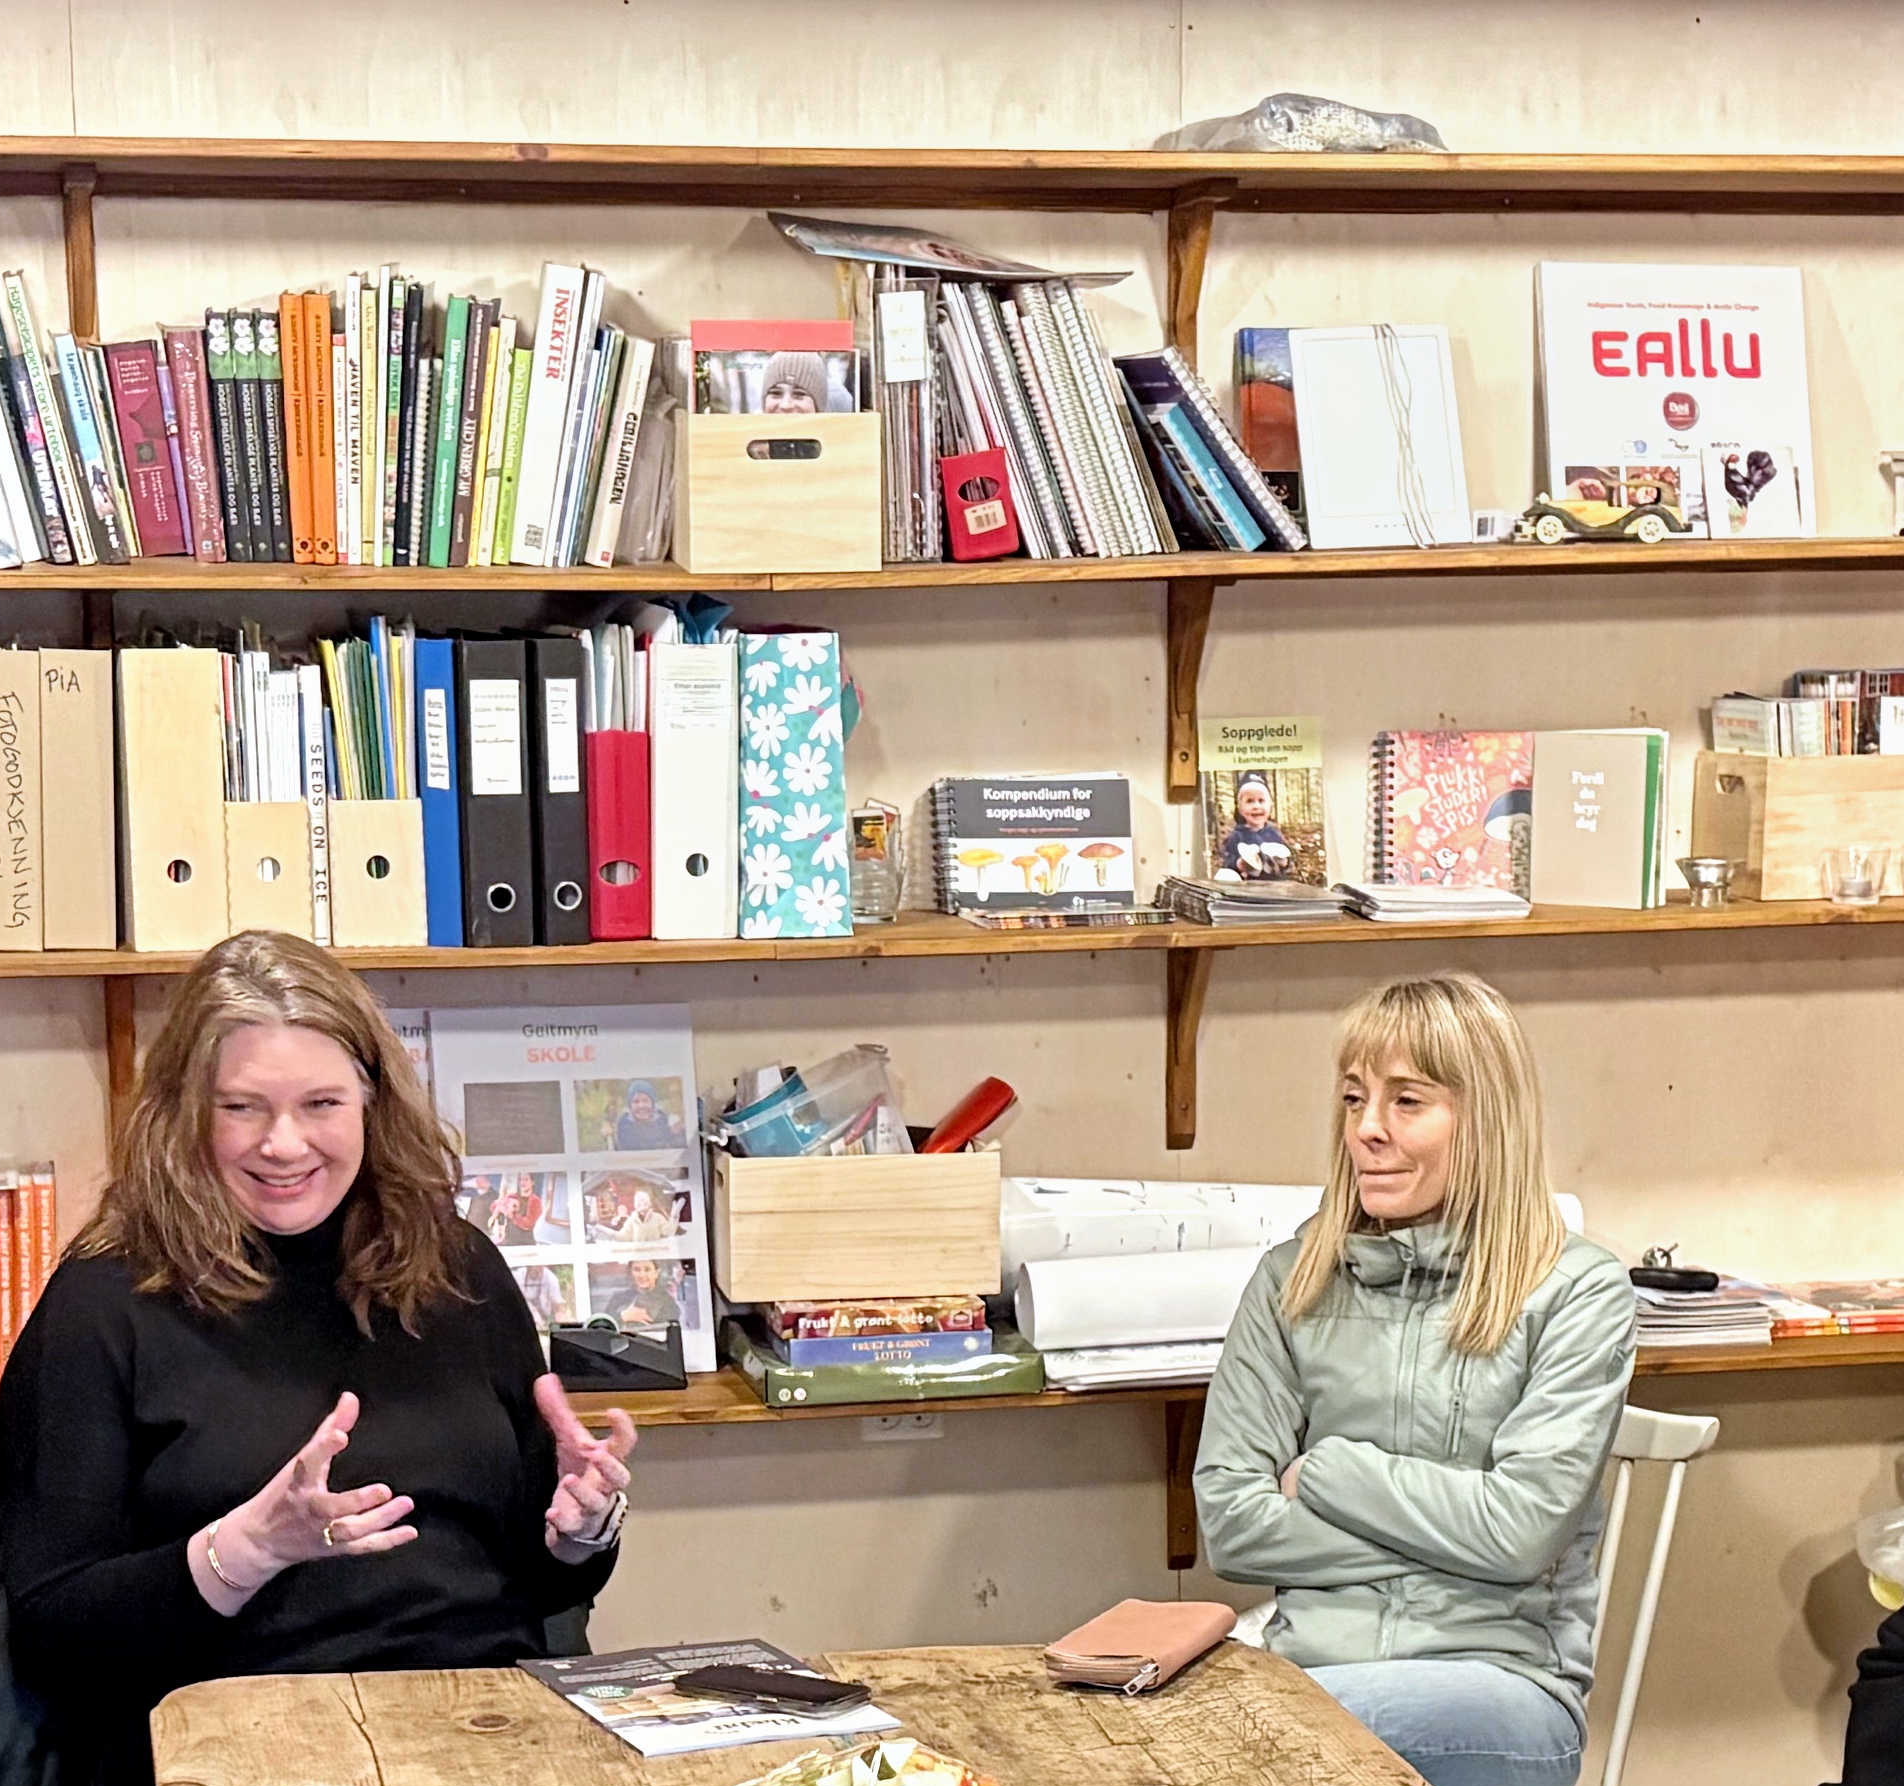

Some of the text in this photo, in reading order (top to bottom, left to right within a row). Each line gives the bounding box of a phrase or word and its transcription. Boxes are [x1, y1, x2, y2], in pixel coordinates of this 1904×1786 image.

[544, 287, 571, 381] INSEKTER
[8, 285, 64, 464] Hageselskapets store urtebok
[350, 421, 360, 434] TIL
[216, 384, 237, 526] NORGES SPISELIGE PLANTER OG BÆR
[350, 438, 361, 485] MAVEN
[457, 416, 478, 497] MY GREEN CITY
[31, 449, 59, 518] UTEMAT
[1221, 724, 1297, 741] Soppglede!
[982, 786, 1093, 804] Kompendium for
[1424, 763, 1485, 797] PLUKK!
[985, 804, 1091, 821] soppsakkyndige
[1423, 783, 1488, 820] STUDER!
[310, 744, 328, 903] SEEDS ON ICE
[1433, 805, 1478, 839] SPIS!
[521, 1023, 599, 1039] Geitmyra
[527, 1045, 598, 1064] SKOLE
[798, 1316, 837, 1334] Frukt
[874, 1350, 912, 1361] LOTTO
